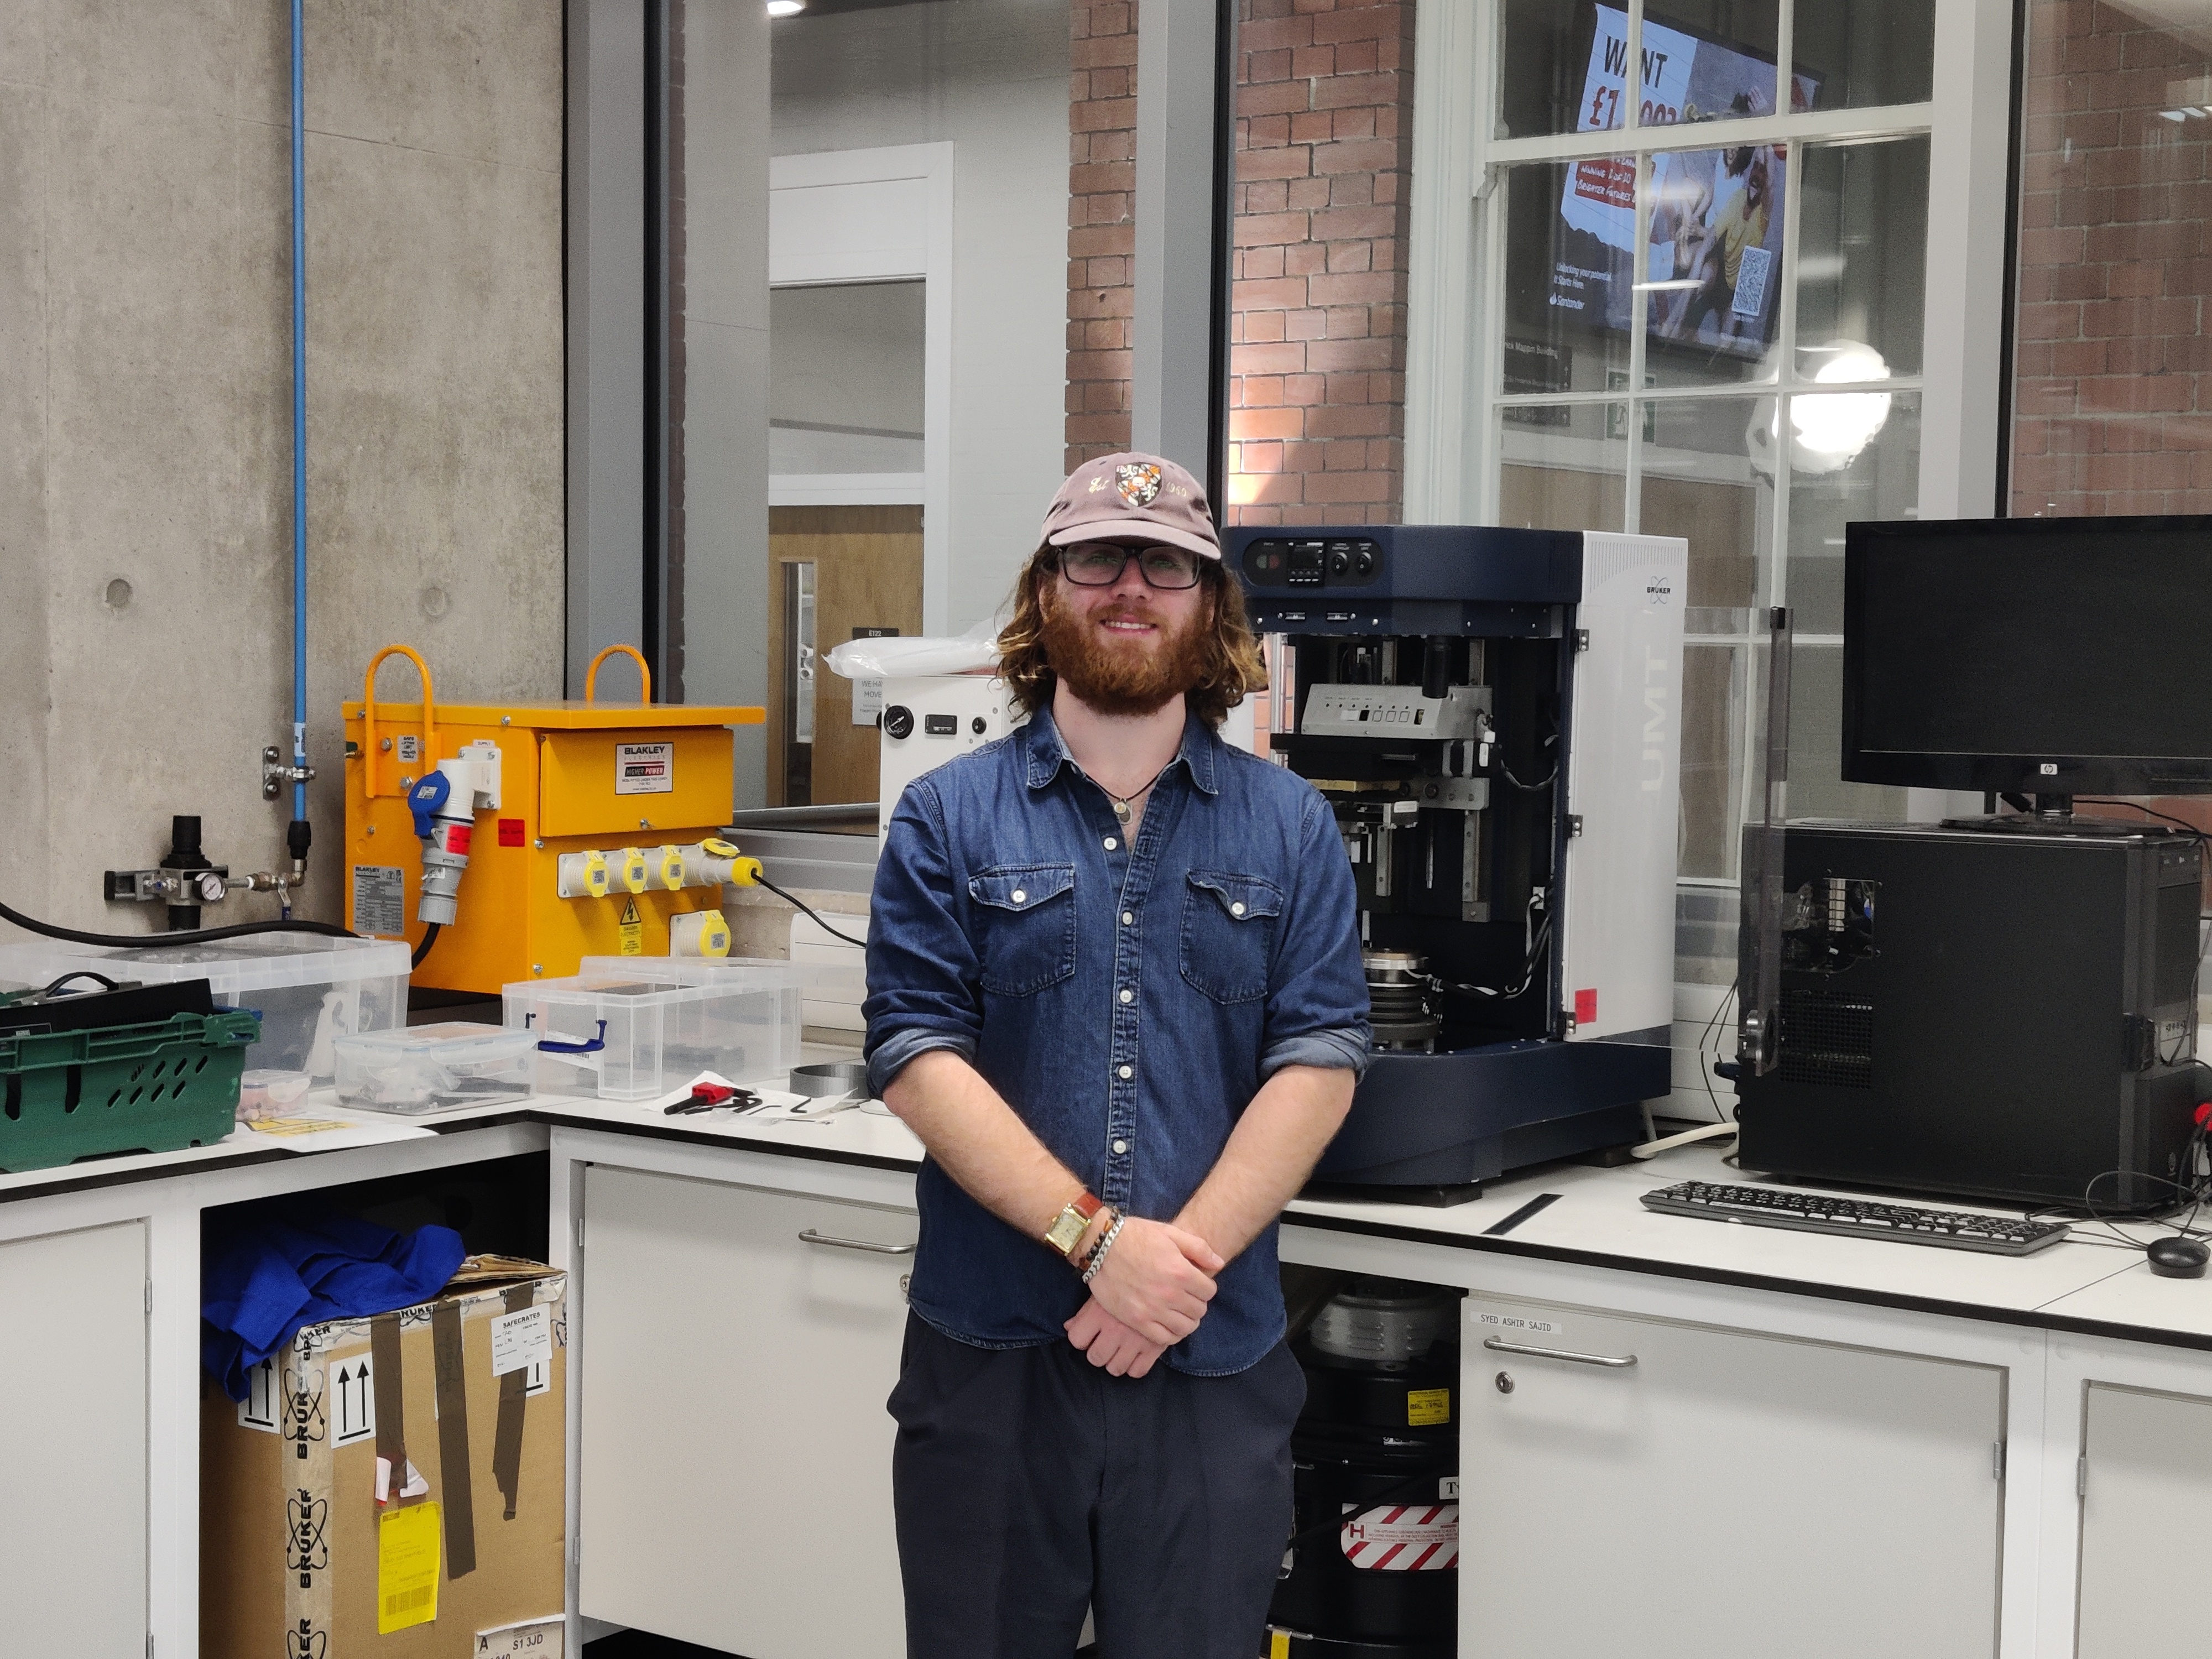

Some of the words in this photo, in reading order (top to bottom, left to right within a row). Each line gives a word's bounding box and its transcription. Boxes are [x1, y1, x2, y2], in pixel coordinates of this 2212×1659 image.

[1557, 295, 1585, 310] Santander
[624, 746, 665, 755] BLAKLEY
[503, 1312, 540, 1328] SAFECRATES
[1481, 1314, 1499, 1324] SYED
[1502, 1317, 1525, 1328] ASHIR
[1528, 1321, 1551, 1332] SAJID
[300, 1488, 312, 1589] BRUKER
[1350, 1524, 1365, 1539] H
[479, 1636, 488, 1652] A
[513, 1639, 523, 1651] S1
[526, 1634, 543, 1647] 3JD
